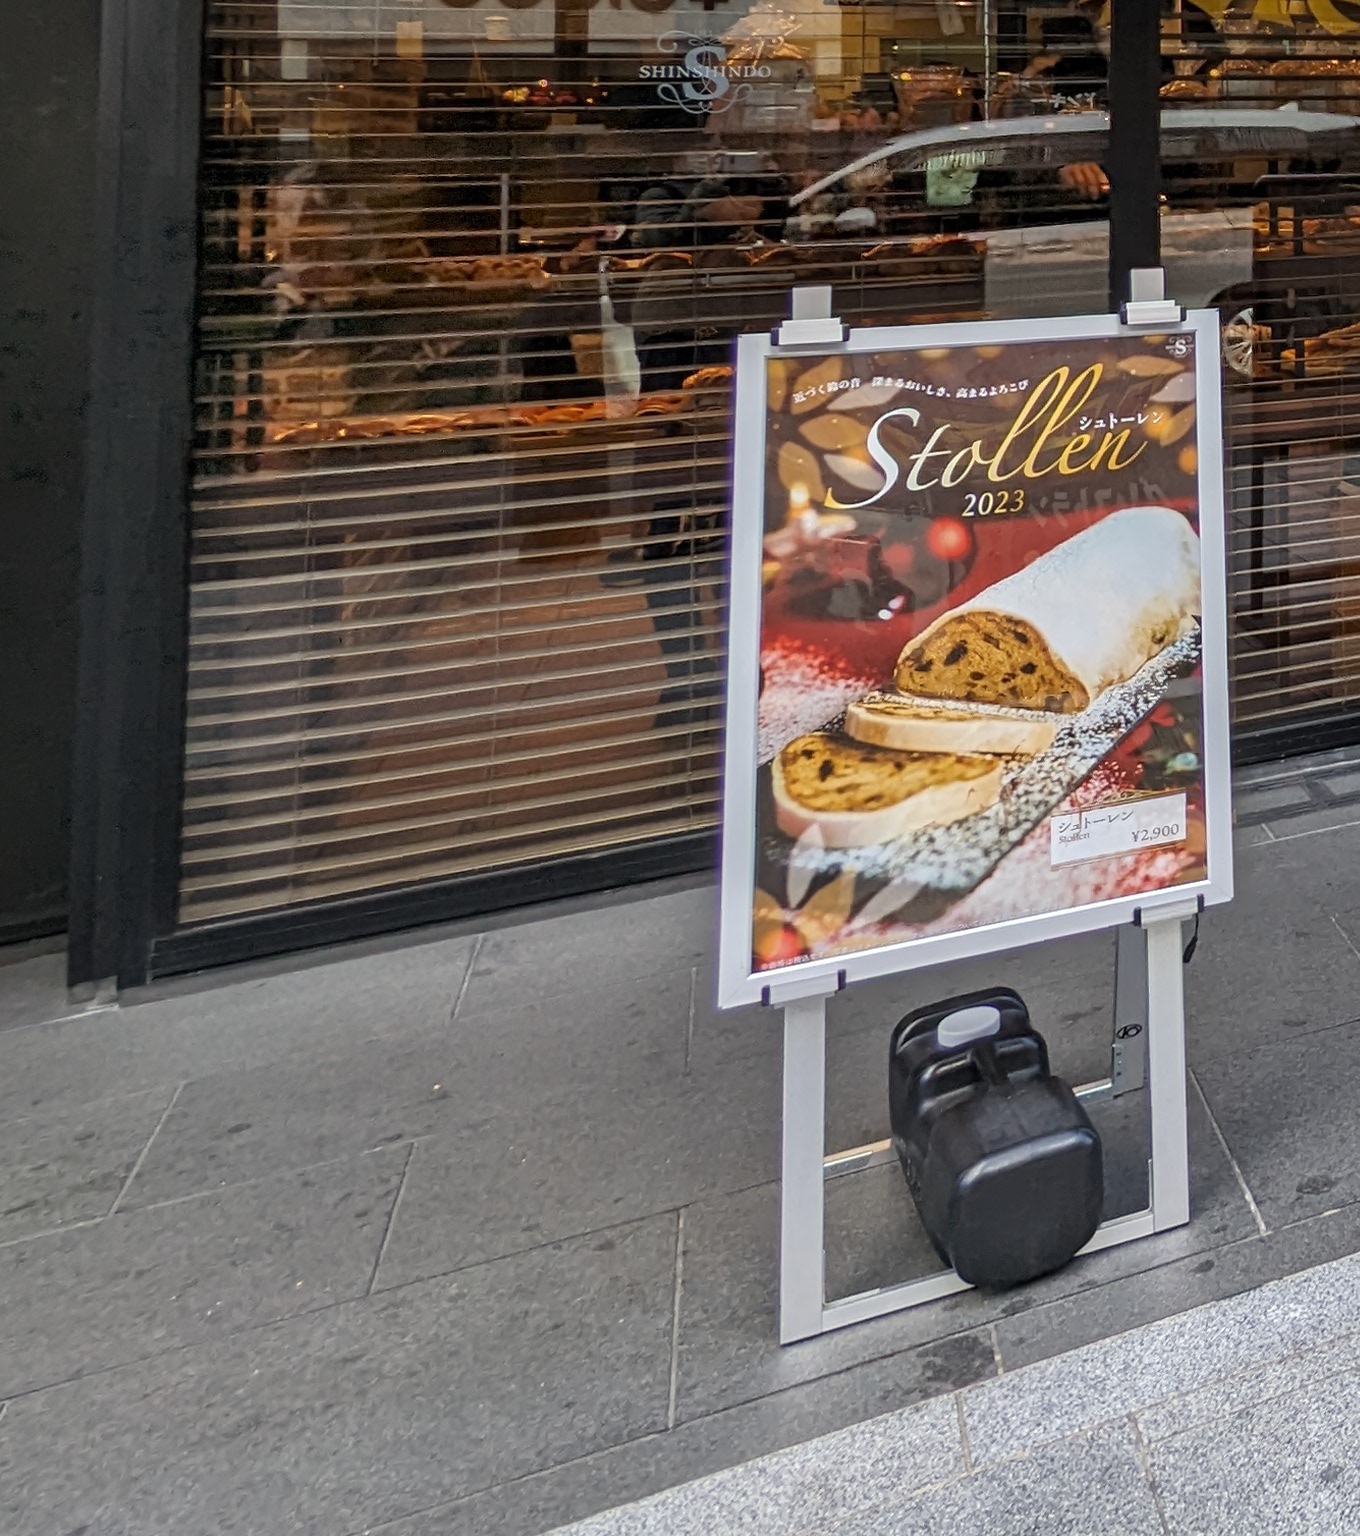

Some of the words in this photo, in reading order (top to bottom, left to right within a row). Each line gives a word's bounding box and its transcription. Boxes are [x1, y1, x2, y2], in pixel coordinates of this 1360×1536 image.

[639, 65, 771, 79] SHINSHINDO
[1079, 411, 1164, 431] シュトーレン
[824, 362, 1149, 510] Stollen
[961, 489, 1025, 517] 2023
[1059, 810, 1134, 833] シュトーレン
[1131, 824, 1180, 843] ¥2,900
